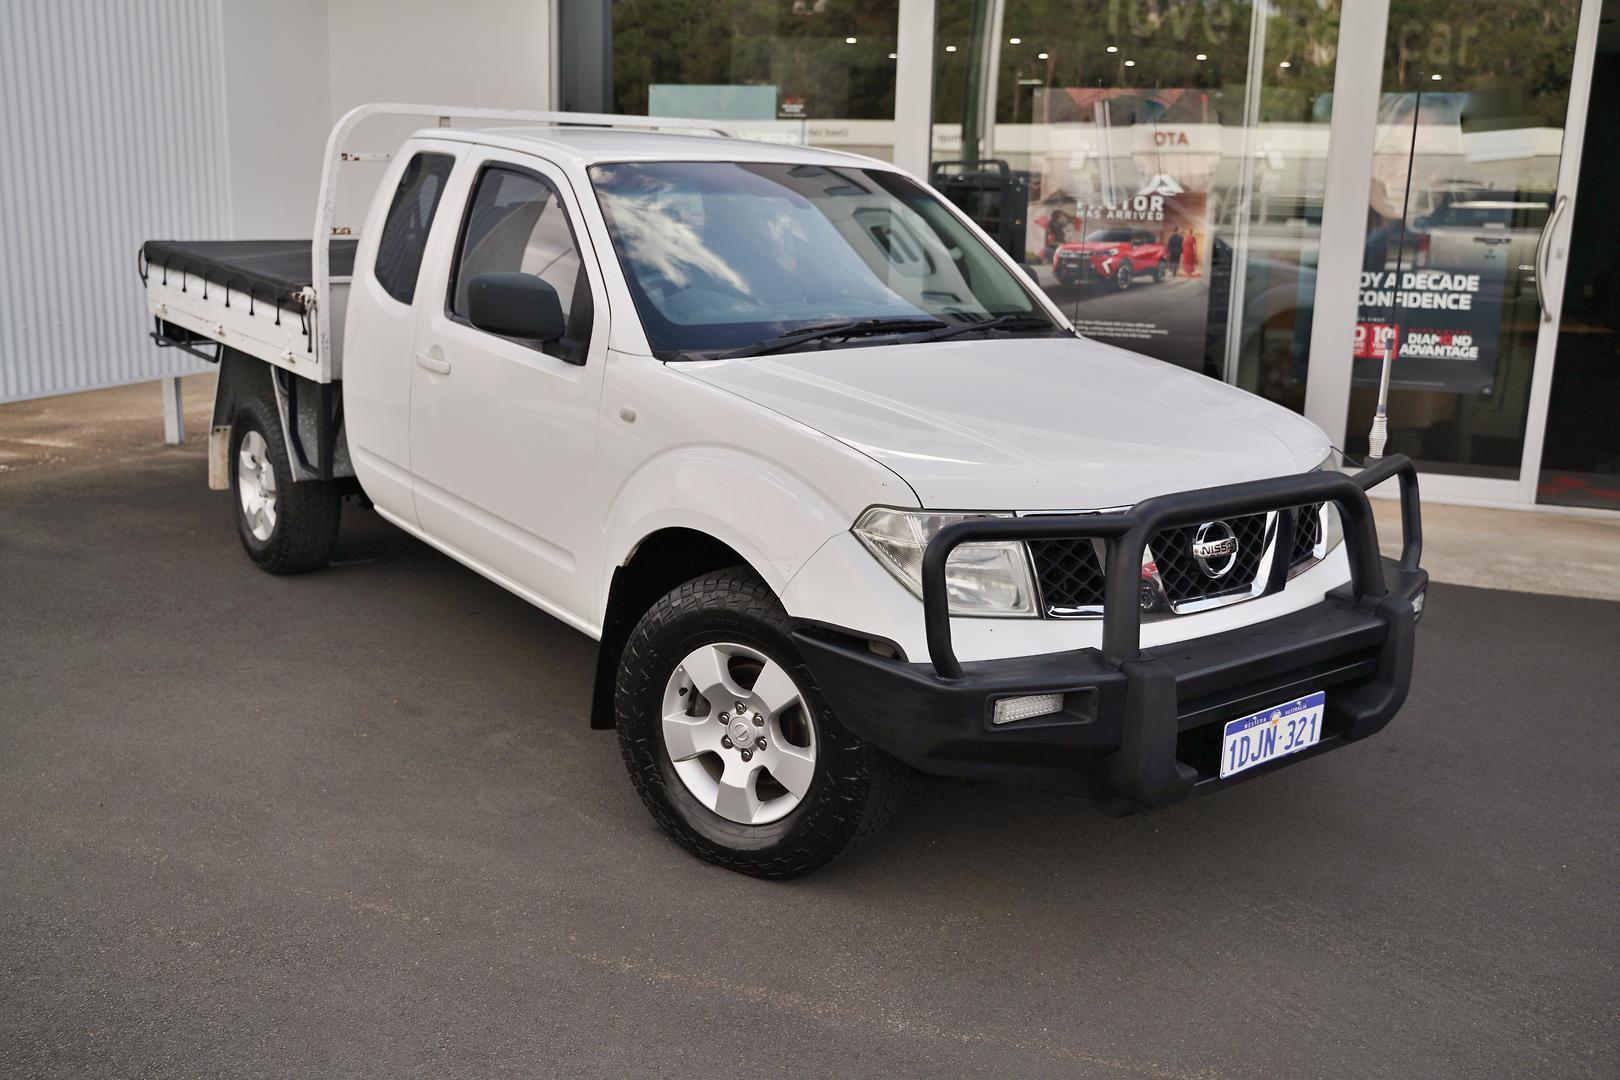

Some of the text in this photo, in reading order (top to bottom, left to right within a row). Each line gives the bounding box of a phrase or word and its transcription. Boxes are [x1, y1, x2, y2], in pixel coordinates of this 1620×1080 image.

[1106, 209, 1164, 221] ARRIVED
[1384, 272, 1397, 289] A
[1401, 272, 1480, 292] DECADE
[1407, 333, 1473, 347] DIAMOND
[1399, 343, 1479, 359] ADVANTAGE
[1284, 704, 1307, 716] AUSTRALIA
